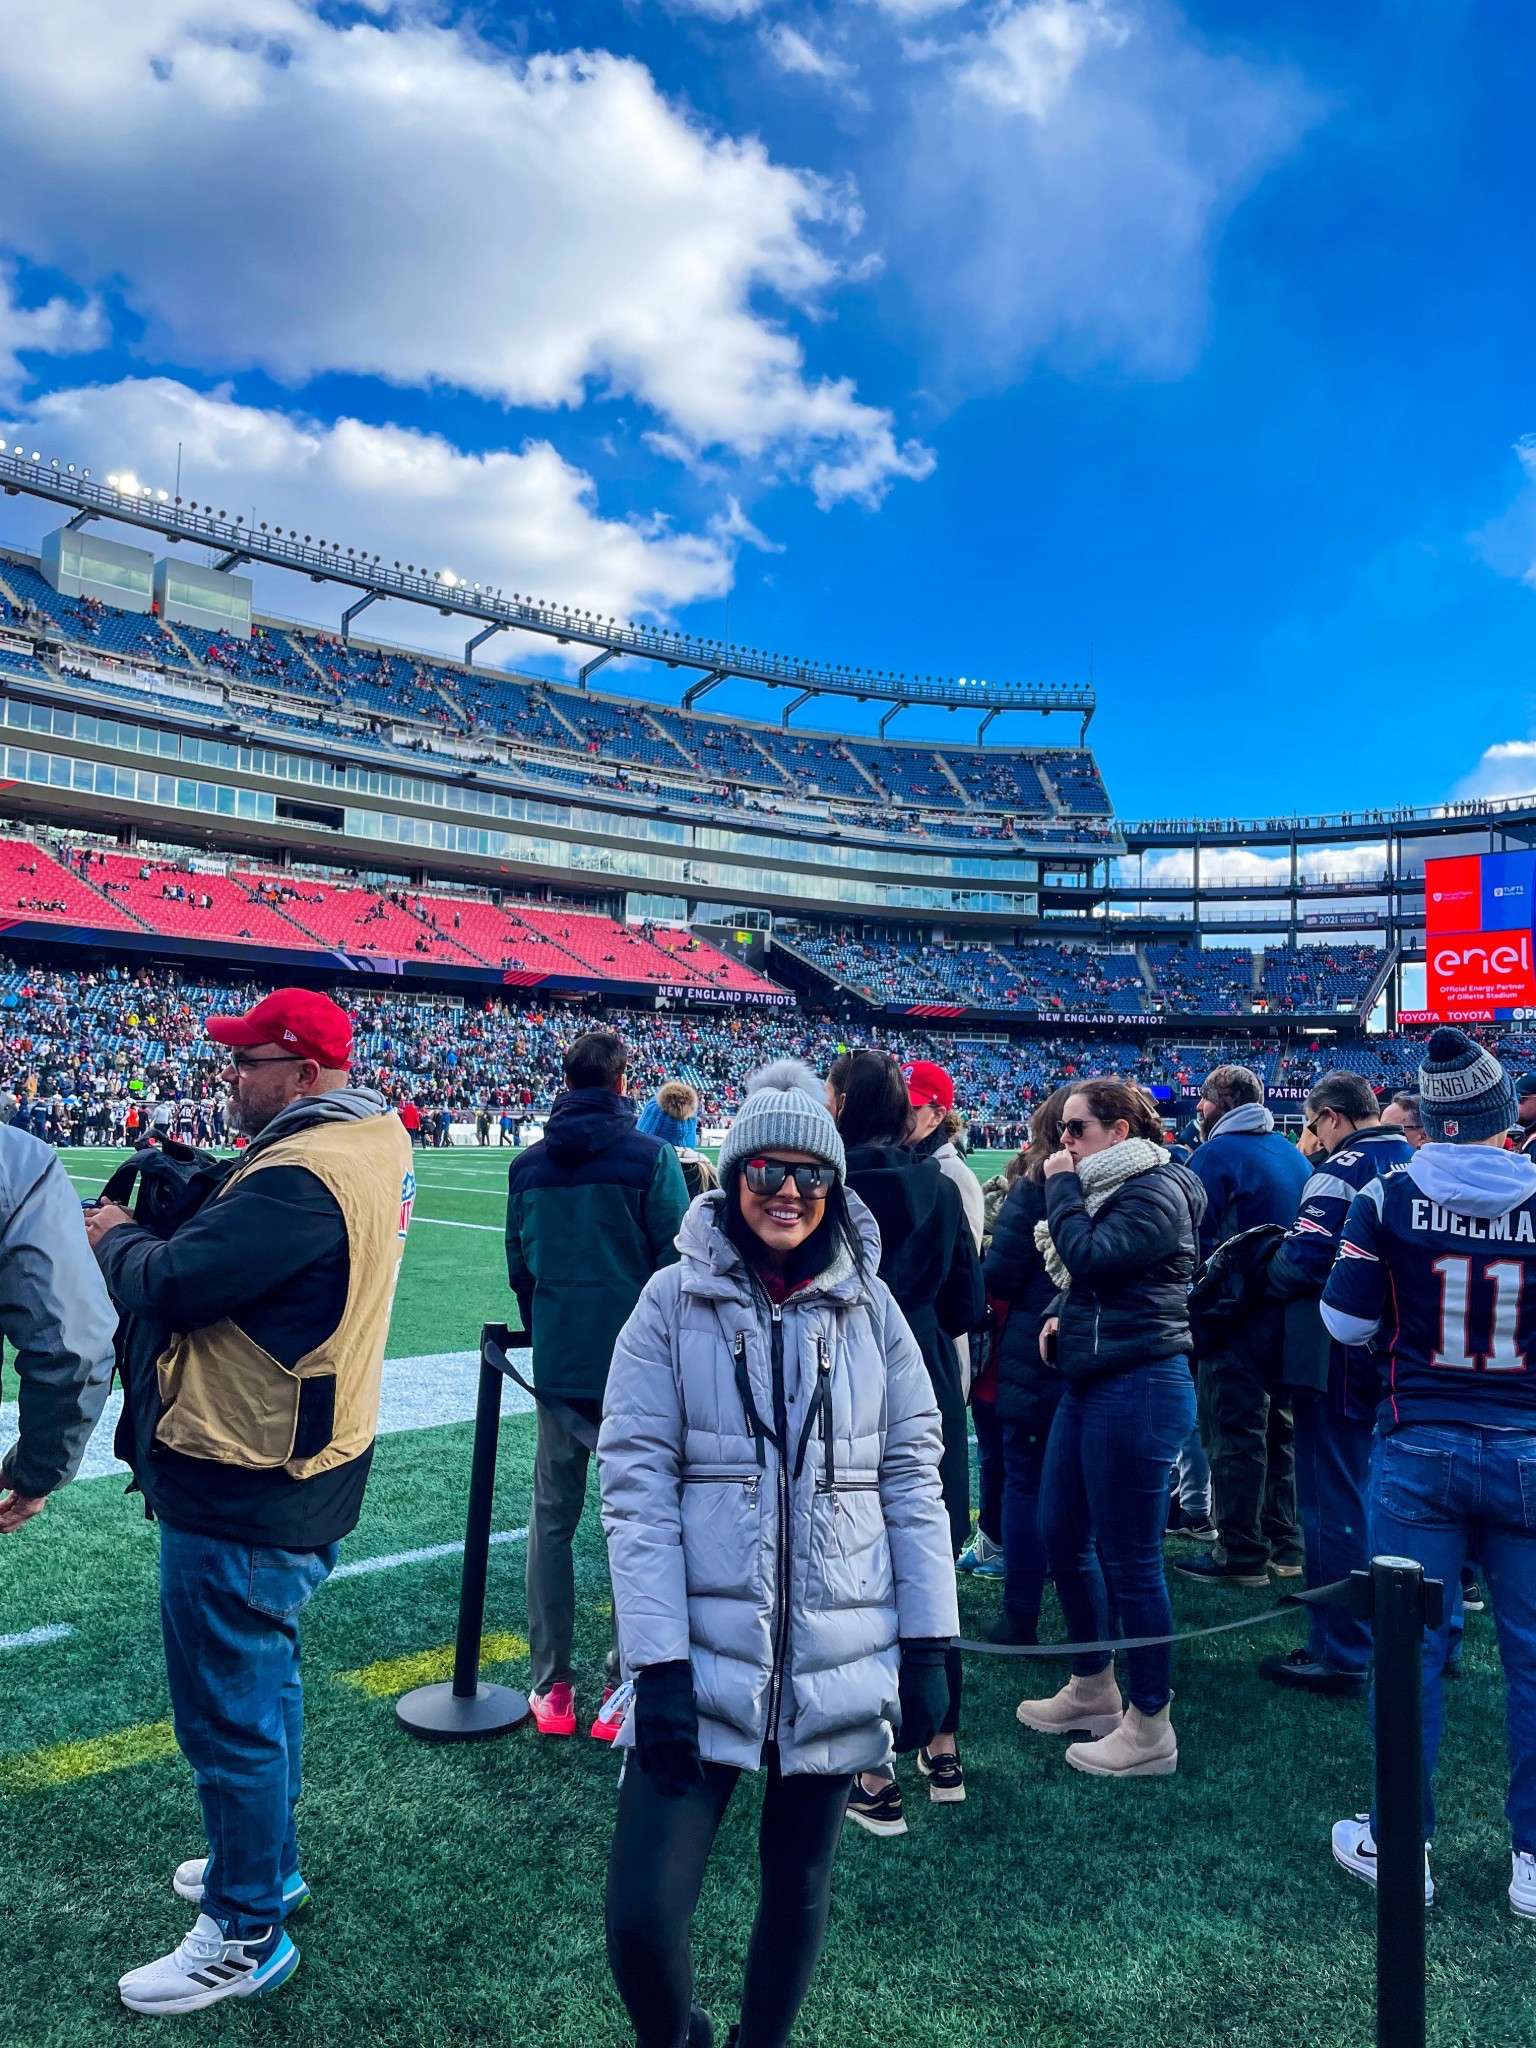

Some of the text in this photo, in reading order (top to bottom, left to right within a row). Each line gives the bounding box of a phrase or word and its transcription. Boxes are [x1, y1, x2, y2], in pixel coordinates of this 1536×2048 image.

[197, 864, 224, 874] Putnam
[1319, 915, 1338, 924] 2021
[1434, 937, 1528, 977] enel
[1440, 985, 1467, 993] Official
[1469, 984, 1494, 992] Energy
[659, 986, 797, 1006] NEW ENGLAND PATRIOTS
[1038, 1013, 1060, 1021] NEW
[1064, 1013, 1114, 1023] ENGLAND
[1398, 1010, 1491, 1022] TOYOTA TOYOTA
[1268, 1088, 1313, 1099] PATRIO
[1430, 1254, 1527, 1372] 11
